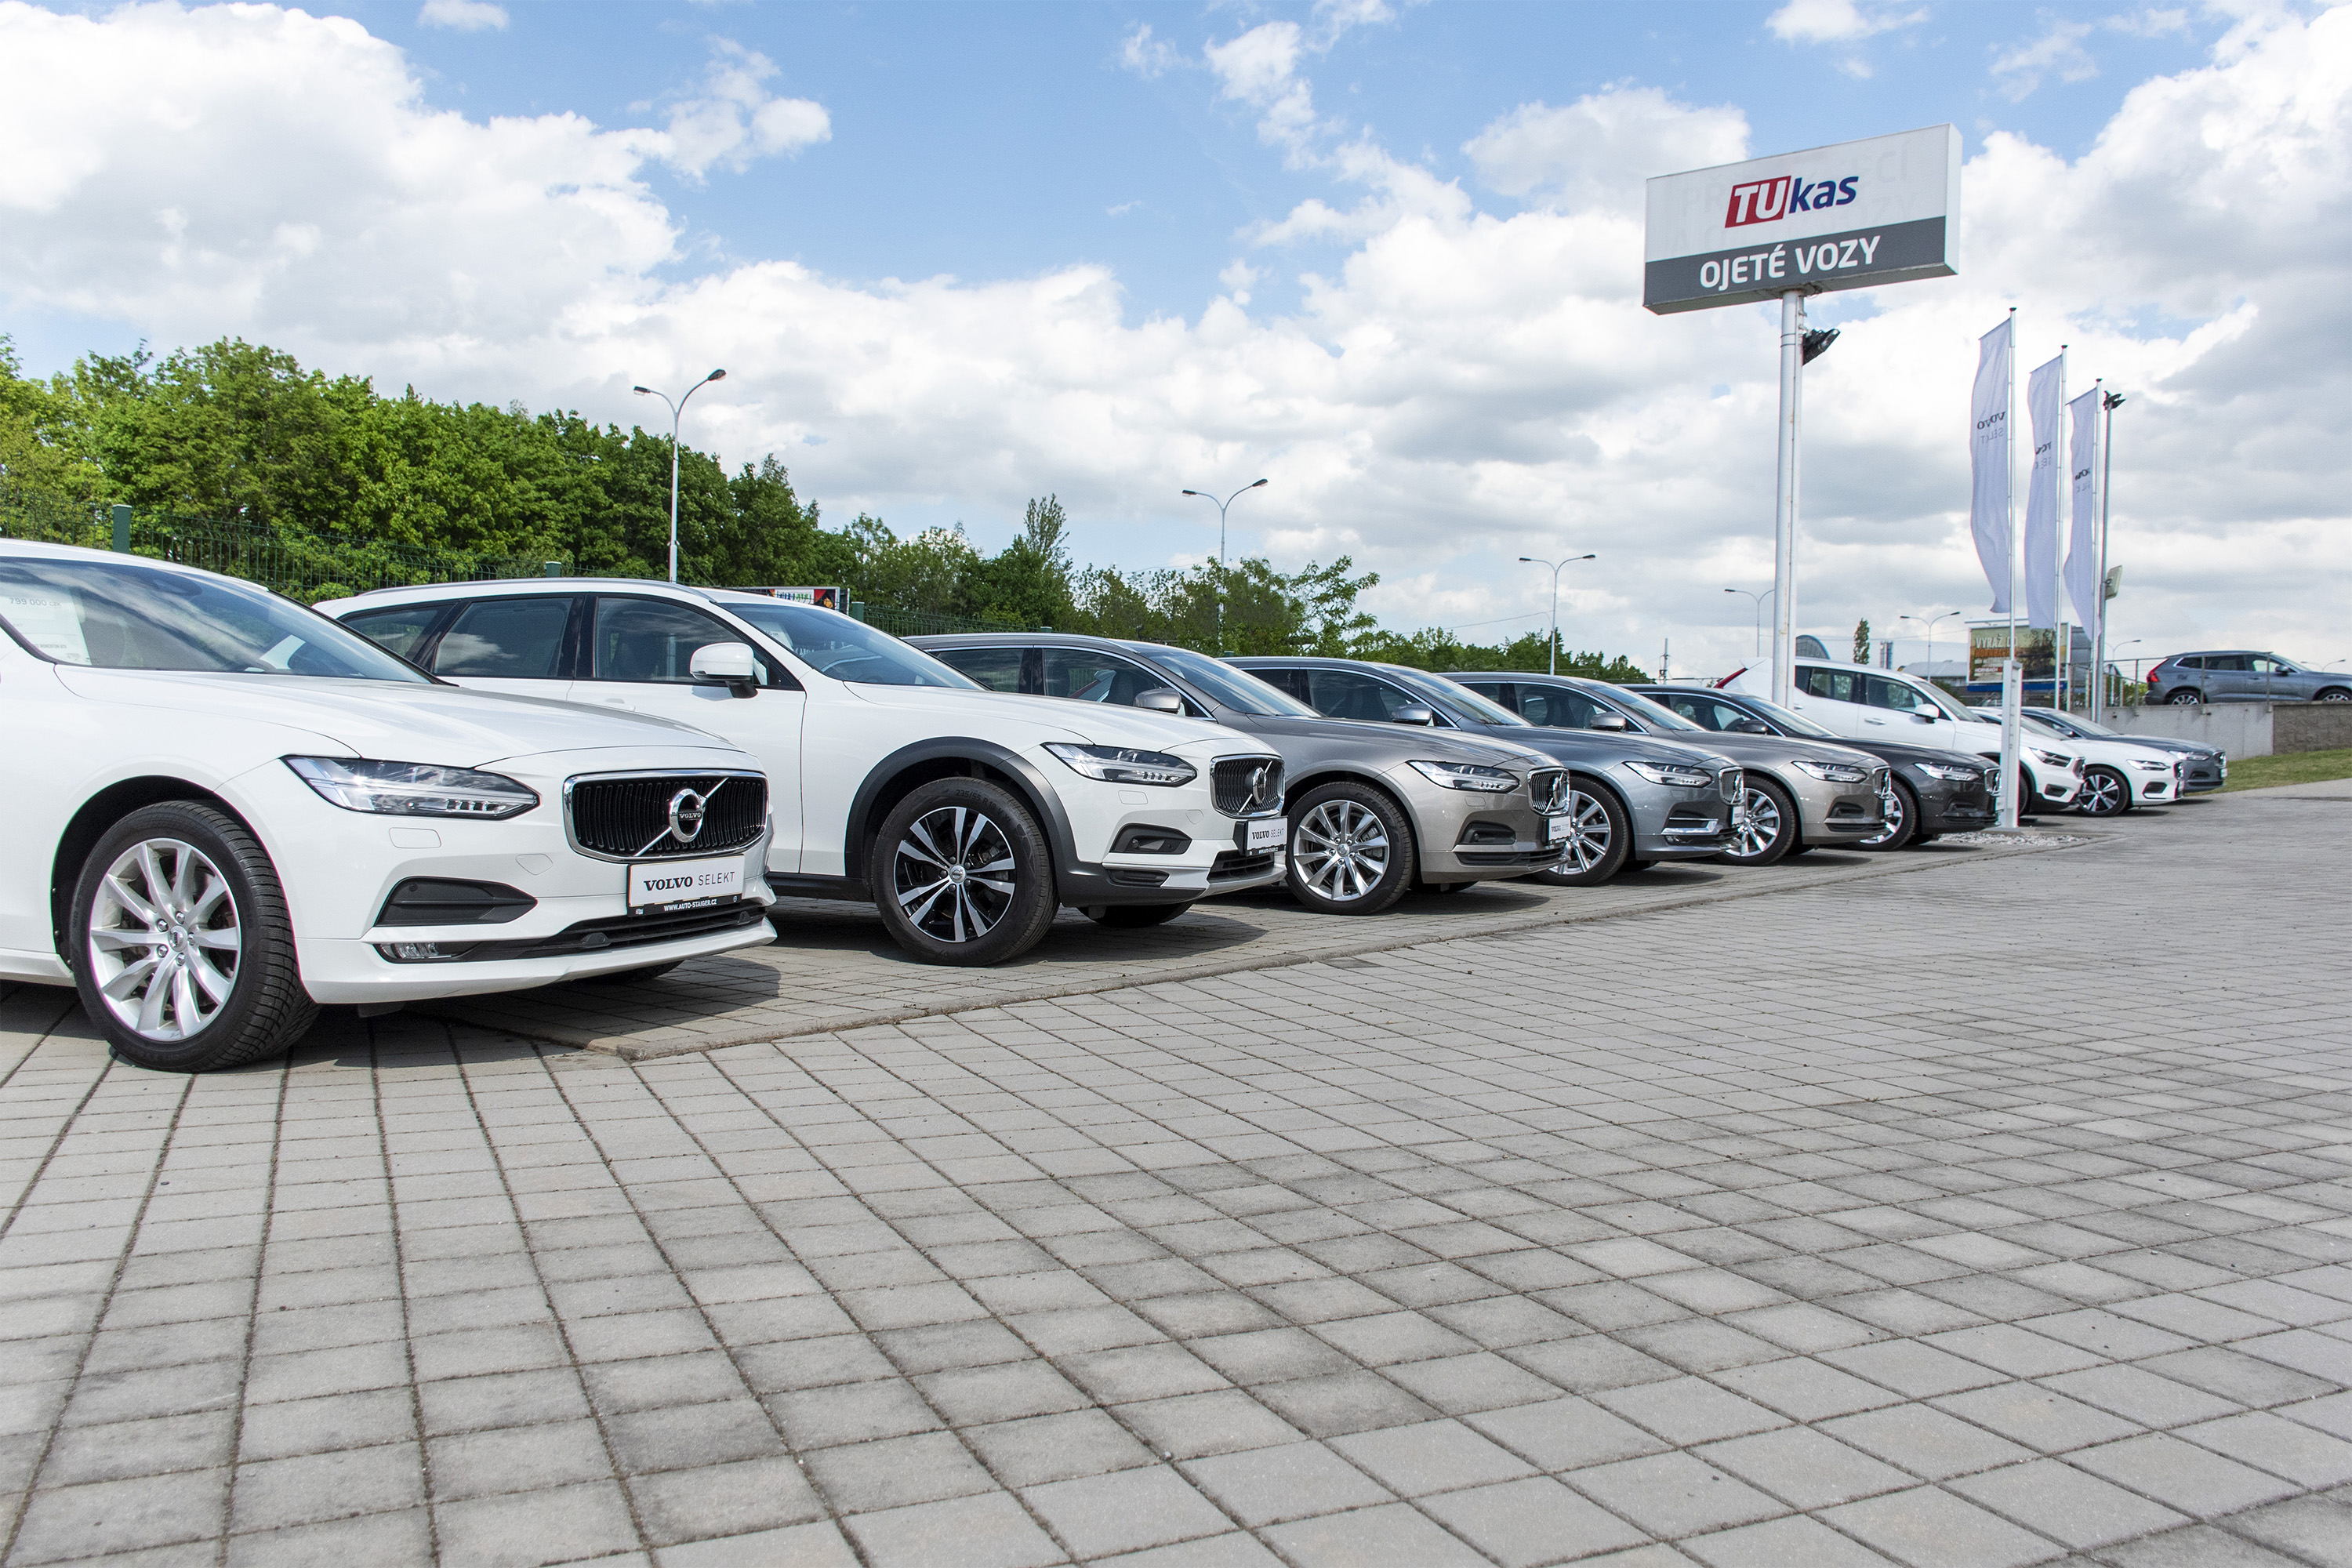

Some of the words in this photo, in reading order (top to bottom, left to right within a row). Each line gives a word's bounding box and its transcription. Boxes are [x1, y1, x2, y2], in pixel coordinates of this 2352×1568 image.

[1729, 176, 1859, 225] TUkas
[1700, 244, 1786, 291] OJETÉ
[1795, 235, 1881, 274] VOZY
[1975, 633, 2003, 648] VYRAŽ
[1251, 830, 1269, 840] VOLVO
[1270, 828, 1284, 838] SELEKT
[644, 876, 693, 891] VOLVO
[698, 871, 735, 887] SELEKT
[664, 898, 717, 912] WWW.AUTO-STAIGER.CZ
